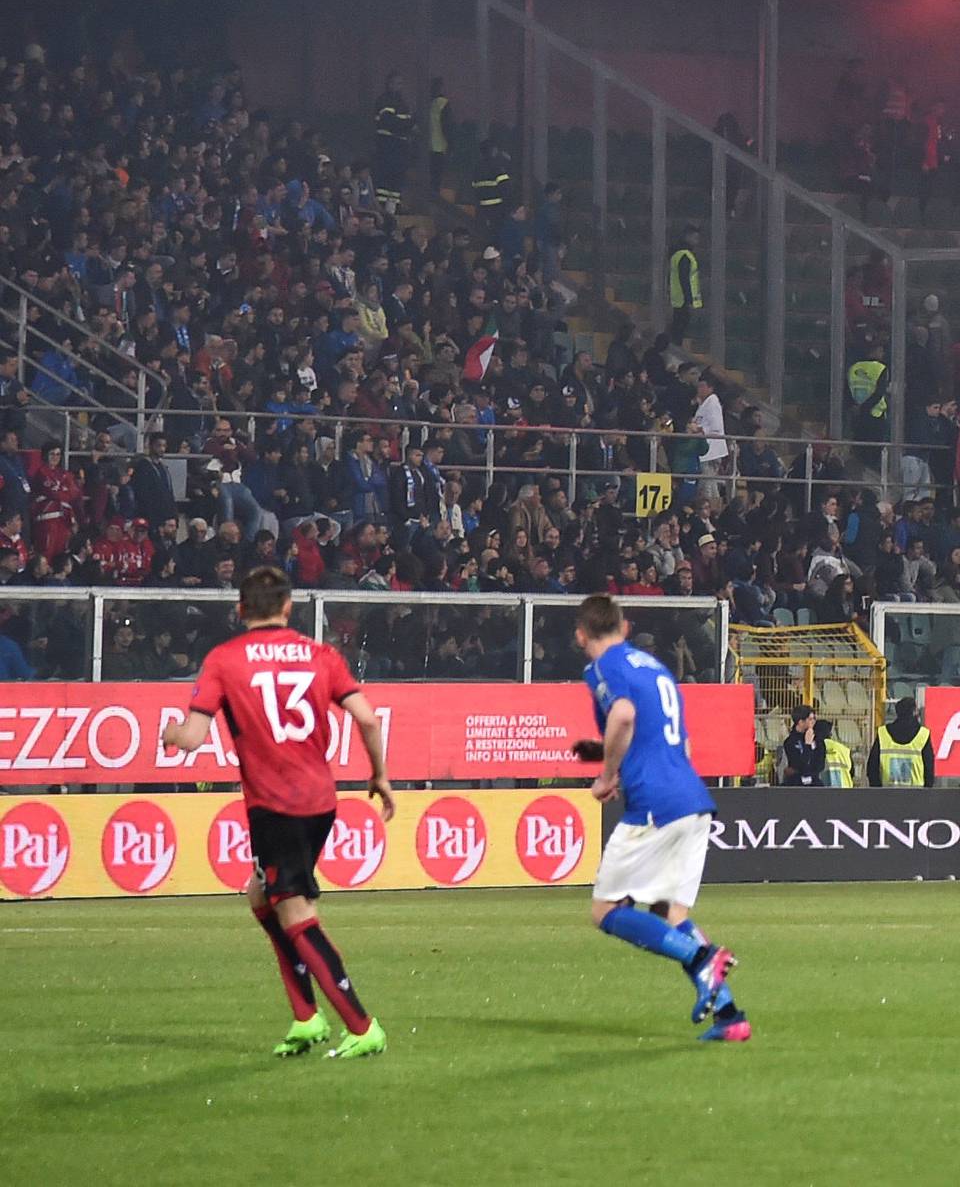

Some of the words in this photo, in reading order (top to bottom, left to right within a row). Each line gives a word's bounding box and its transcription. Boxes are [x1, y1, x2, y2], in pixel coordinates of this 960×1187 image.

[245, 643, 312, 663] KUKELI
[250, 671, 316, 744] 13
[656, 675, 681, 746] 9
[466, 716, 508, 727] OFFERTA
[508, 716, 517, 726] A
[518, 716, 547, 727] POSTI
[466, 727, 506, 738] LIMITATI
[508, 727, 515, 737] E
[515, 727, 567, 738] SOGGETTA
[466, 740, 474, 749] A
[476, 739, 538, 749] RESTRIZIONI.
[466, 752, 491, 762] INFO
[493, 752, 506, 761] SU
[2, 823, 69, 893] Paj
[111, 821, 175, 891] Paj
[217, 820, 255, 864] Pa
[425, 816, 485, 883] Paj
[524, 815, 583, 881] Paj
